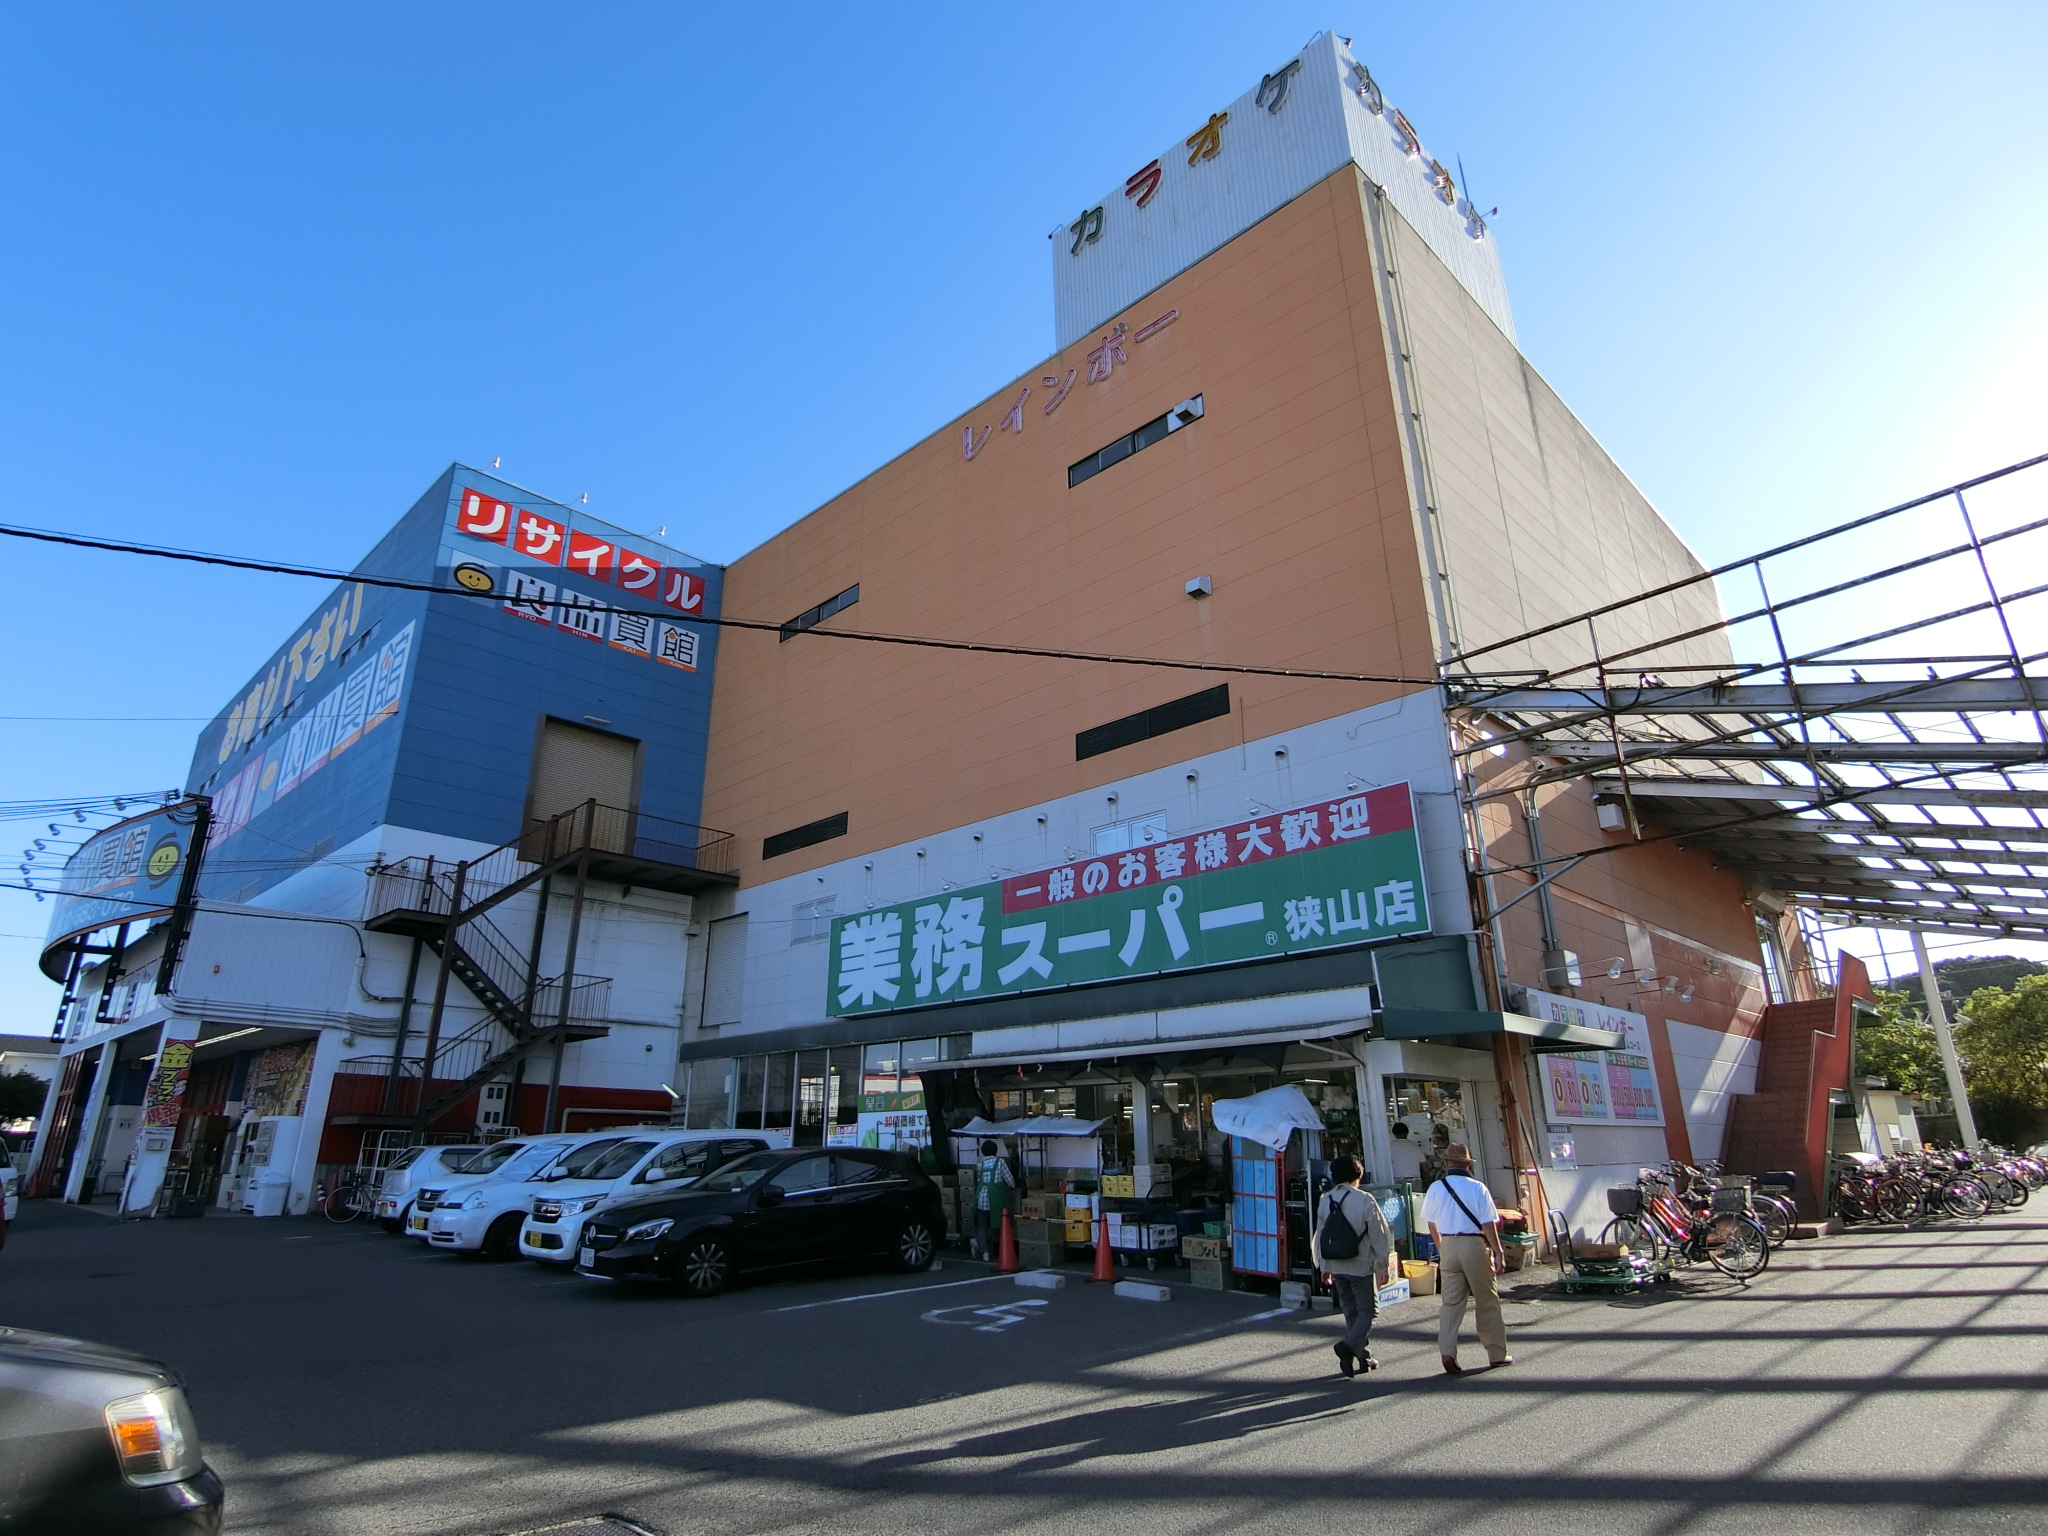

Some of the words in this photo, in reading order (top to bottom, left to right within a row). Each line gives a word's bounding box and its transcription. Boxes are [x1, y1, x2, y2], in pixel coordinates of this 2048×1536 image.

[1070, 58, 1301, 256] カラオケ
[962, 309, 1179, 460] レインボー
[466, 495, 701, 609] リサイクル
[517, 611, 537, 622] RYO
[571, 629, 589, 639] HIN
[1014, 795, 1372, 904] 一般のお客様大歓迎
[836, 883, 1267, 1009] 業務スーパー
[1282, 878, 1420, 942] 狭山店
[1551, 1002, 1585, 1026] カラオケ
[1596, 1011, 1635, 1034] レインボー
